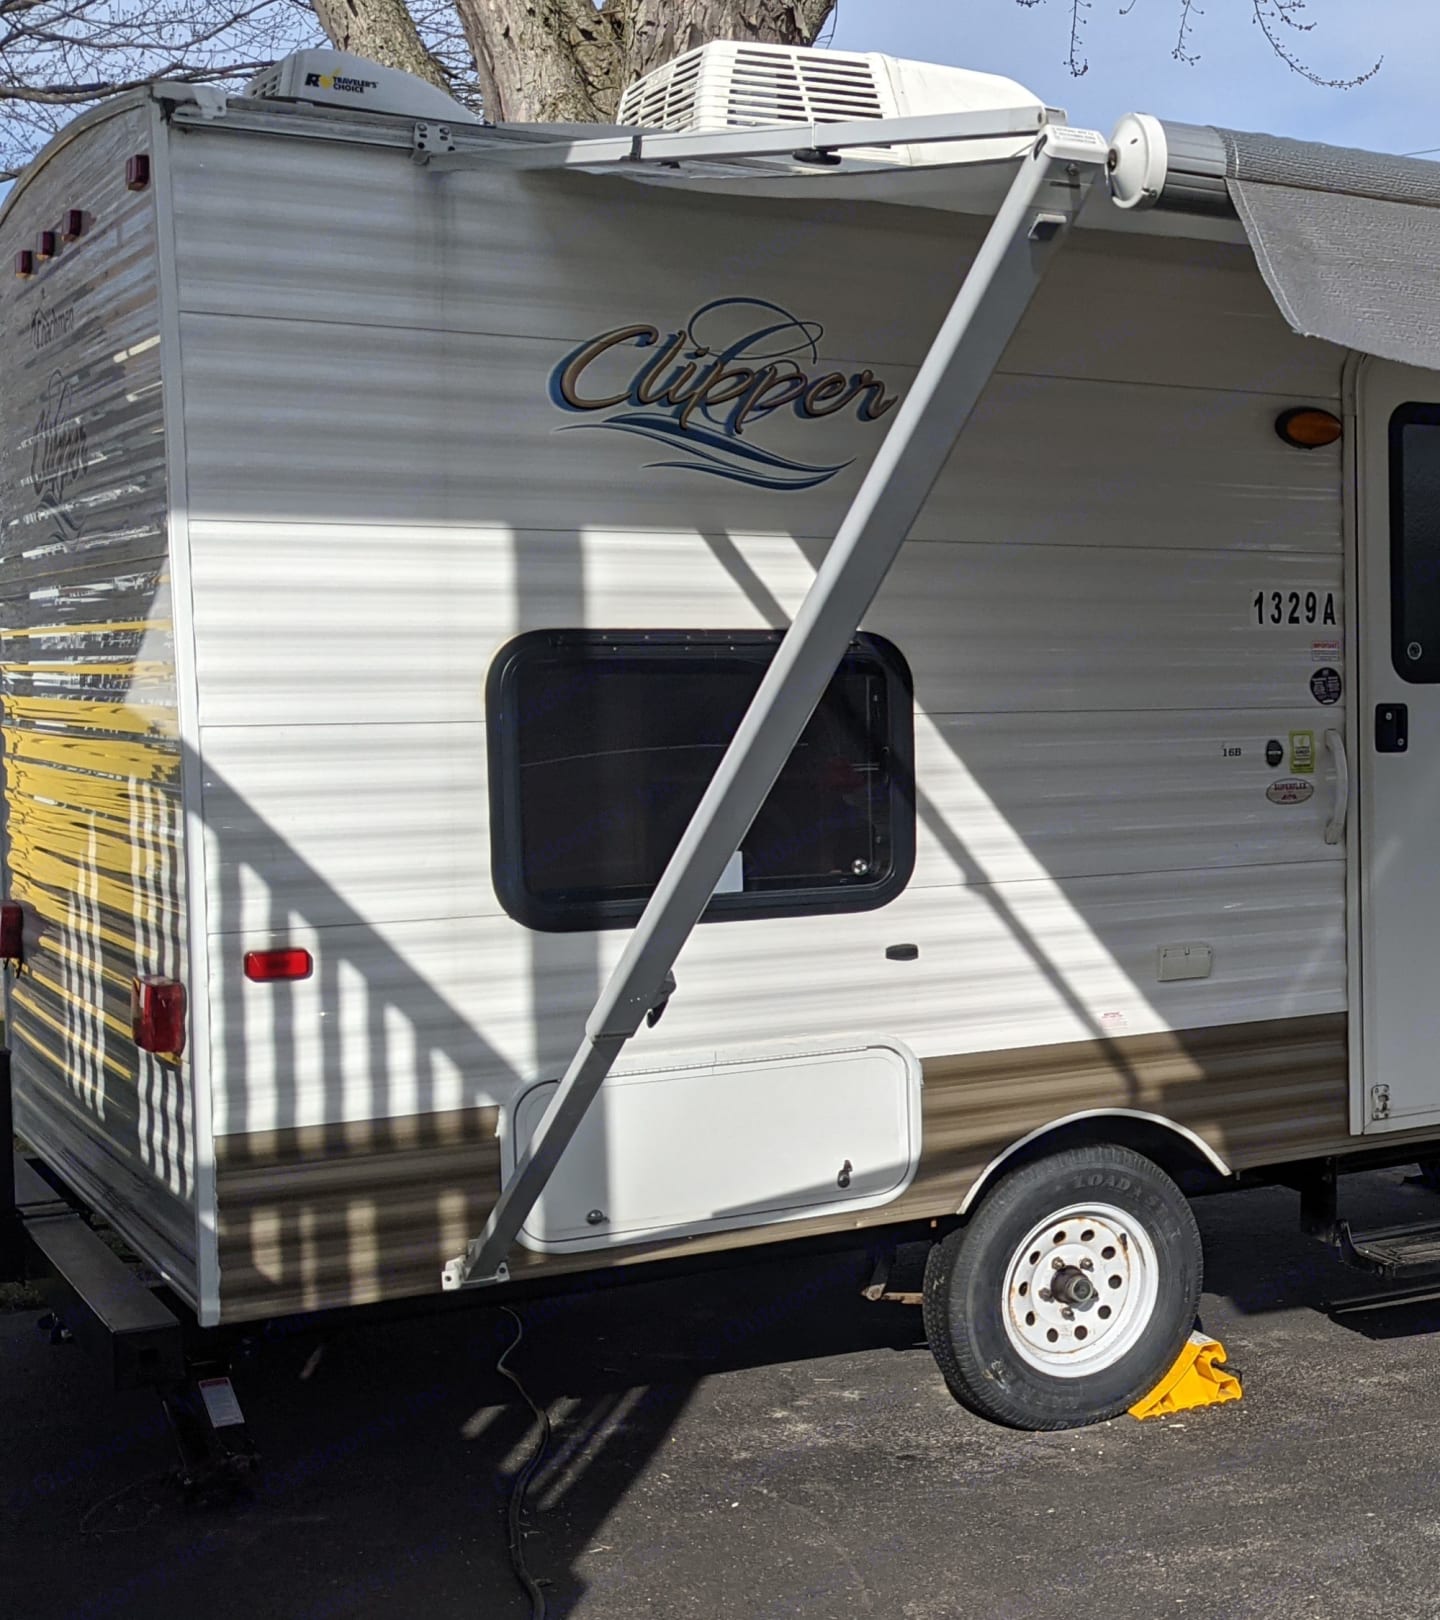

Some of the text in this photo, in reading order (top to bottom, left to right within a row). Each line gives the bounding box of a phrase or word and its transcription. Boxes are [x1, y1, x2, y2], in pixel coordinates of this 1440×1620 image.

[333, 83, 364, 93] CHOICE
[550, 321, 898, 437] Clipper
[1253, 591, 1336, 625] 1329A
